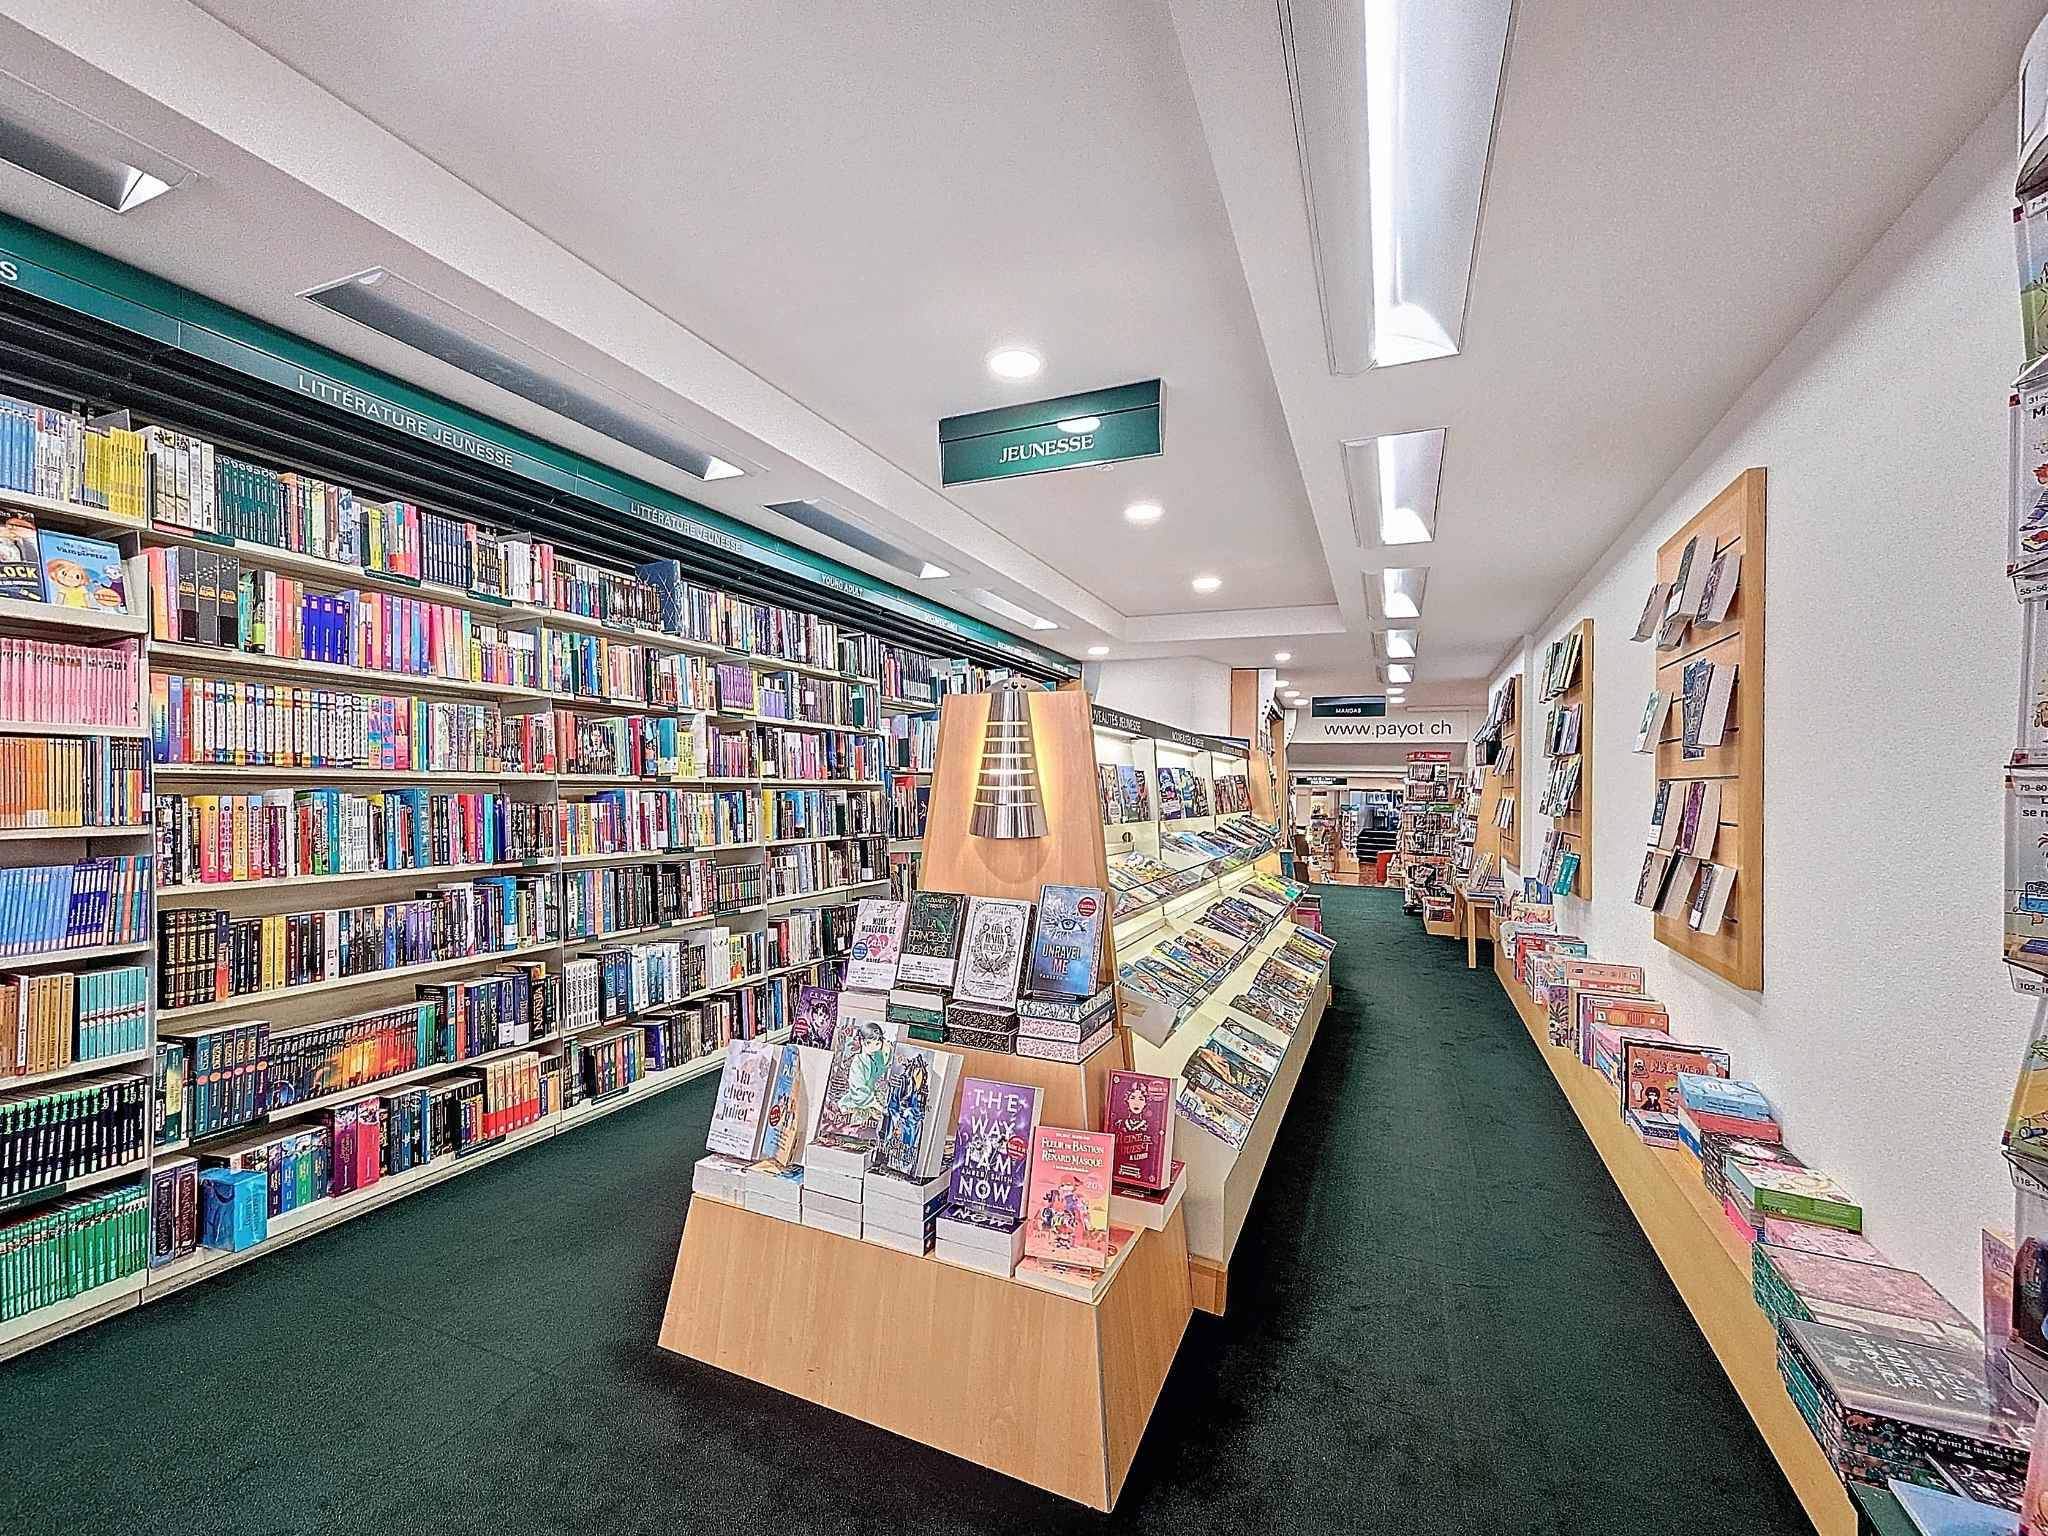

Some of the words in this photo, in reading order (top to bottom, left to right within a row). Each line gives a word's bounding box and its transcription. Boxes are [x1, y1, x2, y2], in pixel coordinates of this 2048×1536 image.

[298, 374, 428, 436] LITTÉRATURE
[433, 428, 513, 468] JEUNESSE
[999, 434, 1095, 464] JEUNESSE
[630, 502, 696, 536] LITTÉRATURE
[696, 526, 742, 552] JEUNESSE
[820, 573, 844, 591] YOUNG
[844, 582, 865, 598] ADULT
[908, 929, 953, 945] PRINCESSE
[1053, 959, 1069, 975] ME
[723, 1083, 755, 1103] chère
[974, 1088, 1019, 1113] THE
[971, 1115, 1016, 1139] WAY
[1041, 1136, 1065, 1149] FLEUR
[1072, 1141, 1105, 1155] BASTION
[977, 1150, 1012, 1175] AM
[958, 1175, 1011, 1204] NOW
